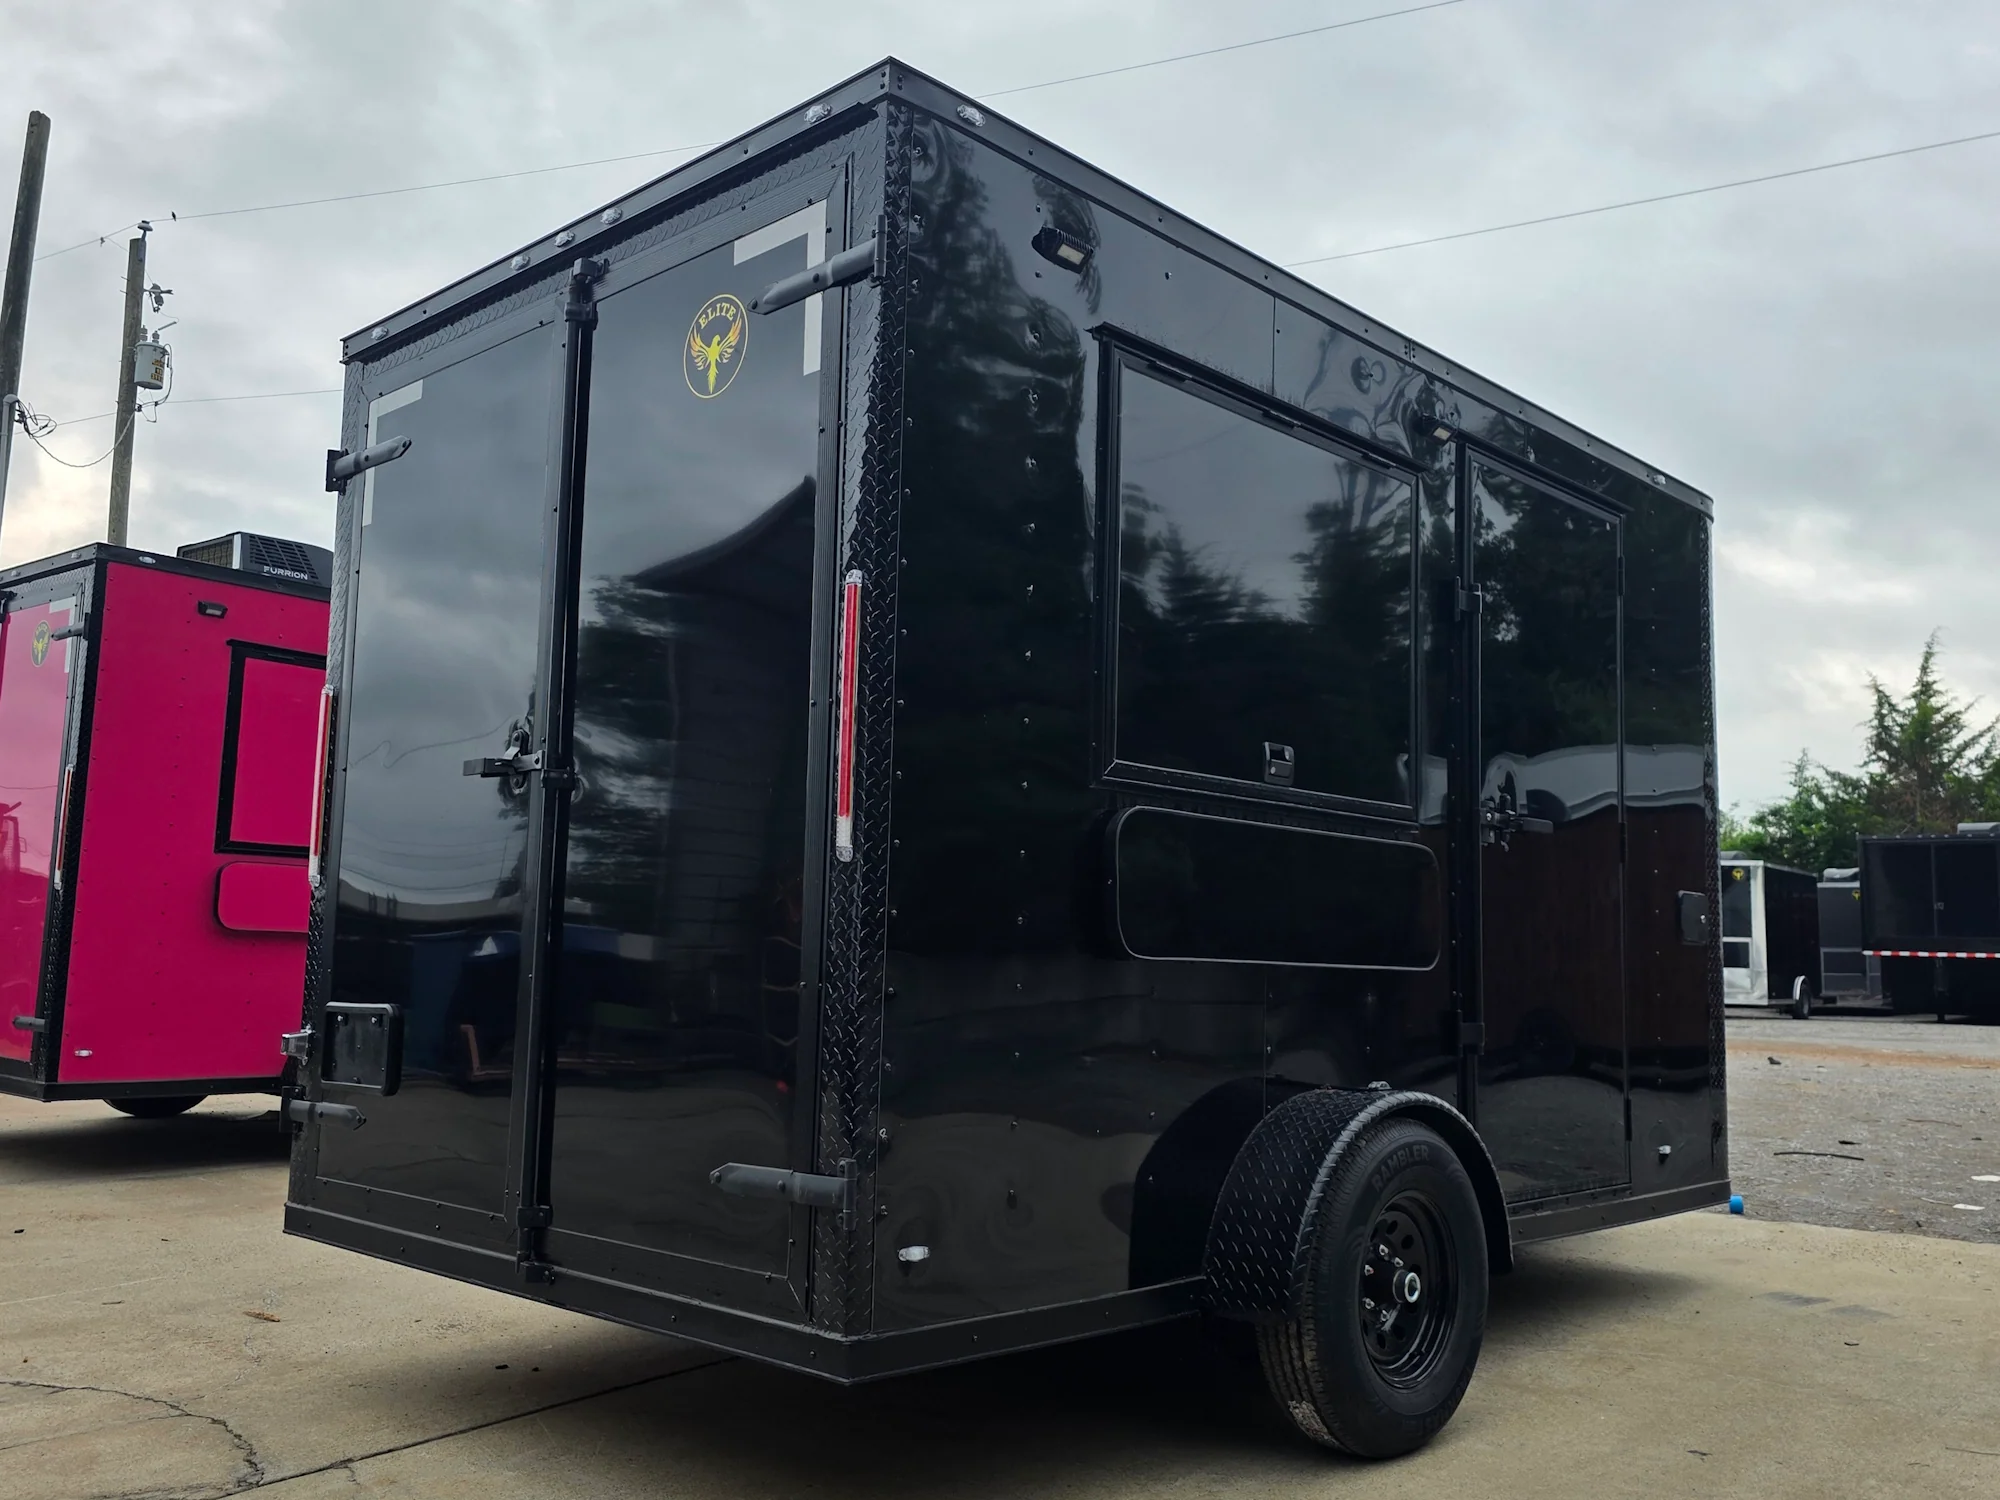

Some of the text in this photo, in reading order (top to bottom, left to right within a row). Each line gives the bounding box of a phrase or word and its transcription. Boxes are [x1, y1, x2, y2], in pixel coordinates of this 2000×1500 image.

[699, 302, 737, 329] ELITE
[263, 565, 308, 580] FURRION
[1371, 1144, 1429, 1193] RAMBLER
